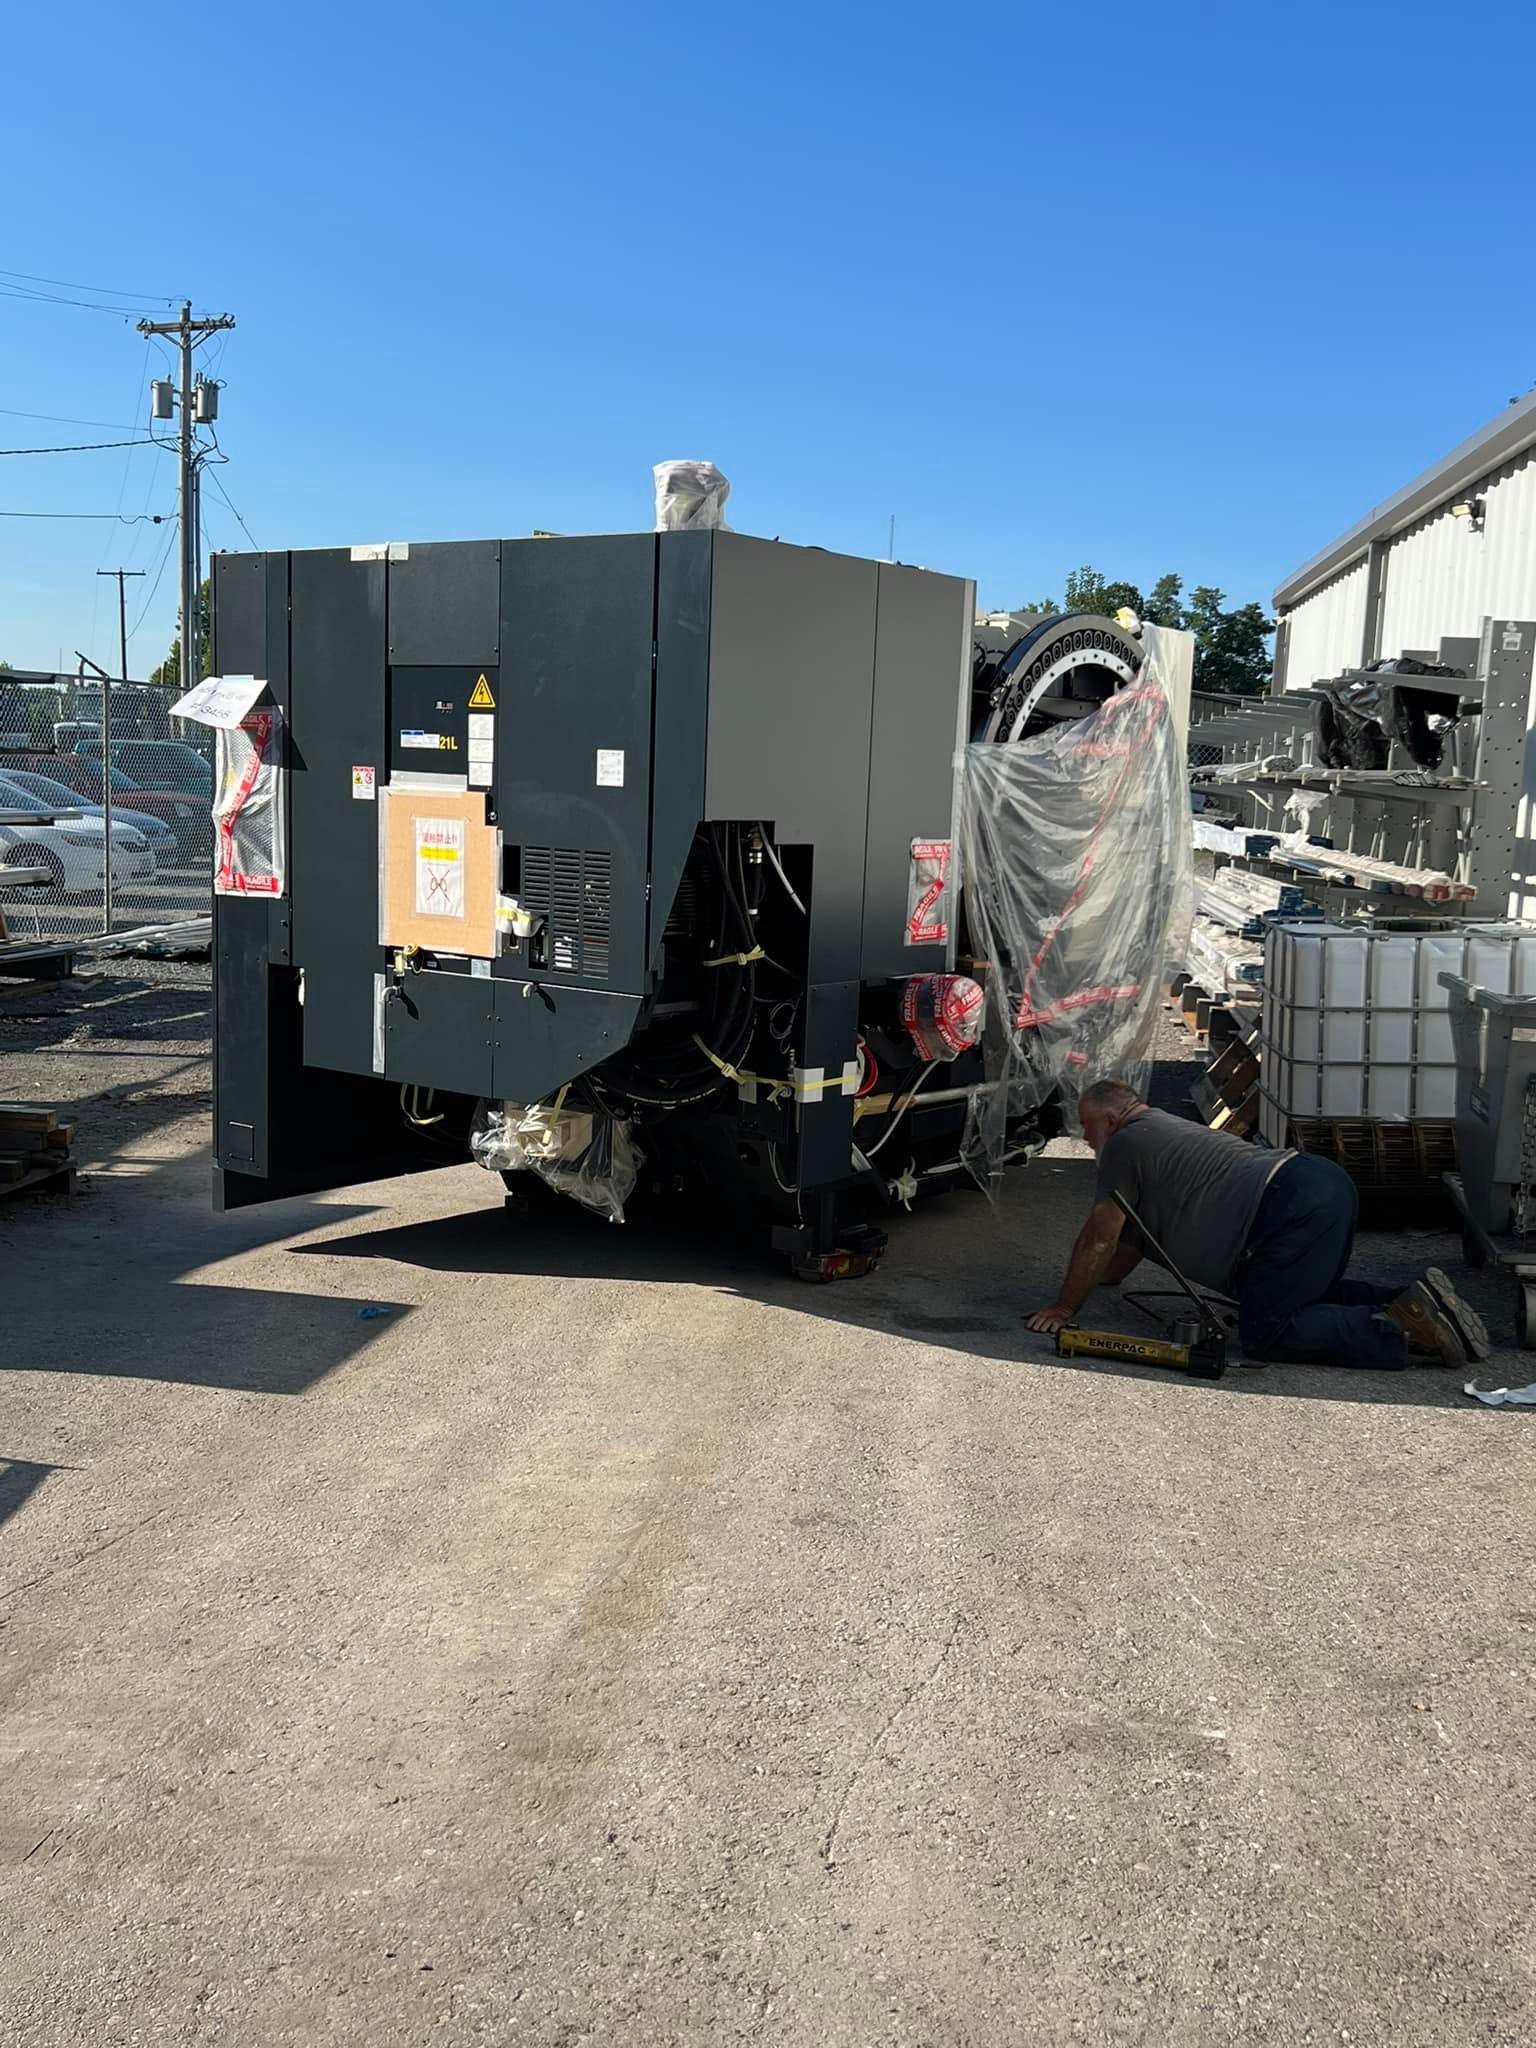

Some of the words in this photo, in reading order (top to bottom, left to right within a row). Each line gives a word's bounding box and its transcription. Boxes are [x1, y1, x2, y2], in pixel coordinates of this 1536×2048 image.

[439, 736, 458, 750] 21L
[914, 884, 938, 919] FRAGILE
[903, 983, 915, 1022] FRAGILE
[1089, 1338, 1146, 1354] ENERPAC
